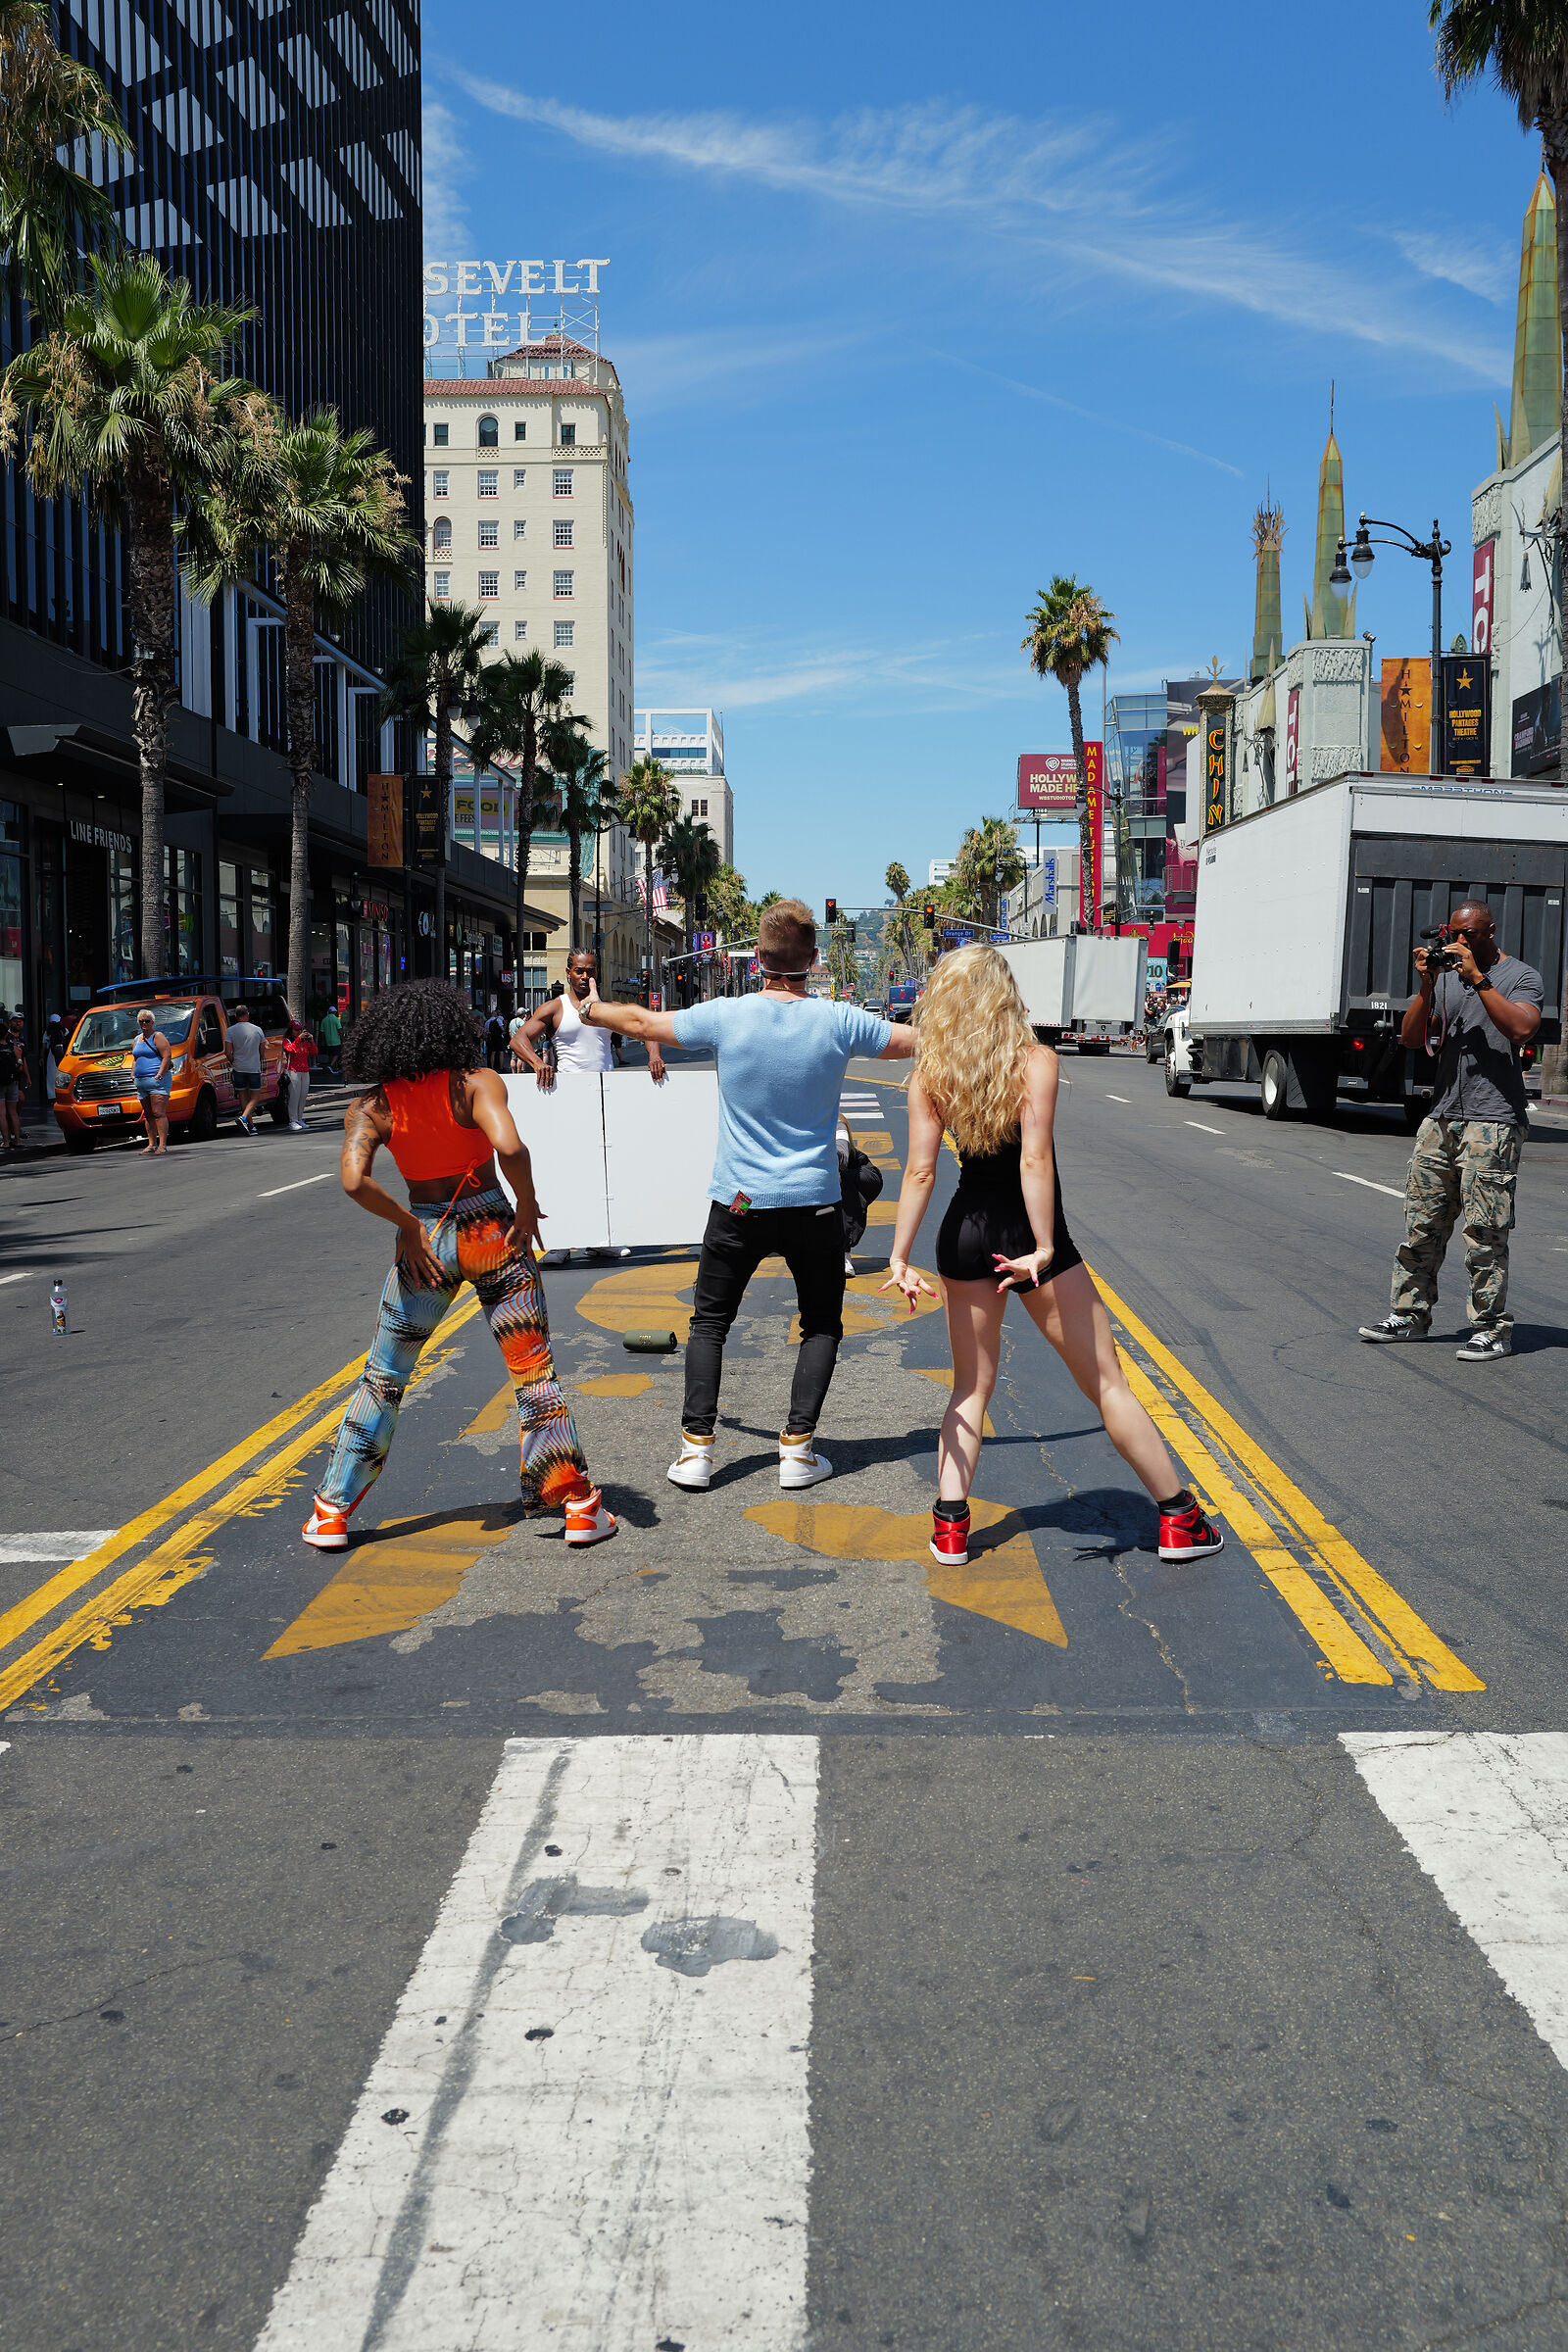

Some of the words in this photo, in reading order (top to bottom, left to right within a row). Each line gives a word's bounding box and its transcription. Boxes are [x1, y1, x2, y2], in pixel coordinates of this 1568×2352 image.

[423, 258, 611, 296] SEVELT
[1449, 710, 1482, 718] HOLLYWOOD
[1451, 718, 1479, 727] PANTAGES
[1030, 784, 1063, 793] MADE
[1207, 728, 1224, 833] CHIN
[71, 820, 92, 844] LINE
[94, 827, 132, 854] FRIENDS
[1045, 858, 1055, 906] Marshalls
[1147, 965, 1163, 977] 10
